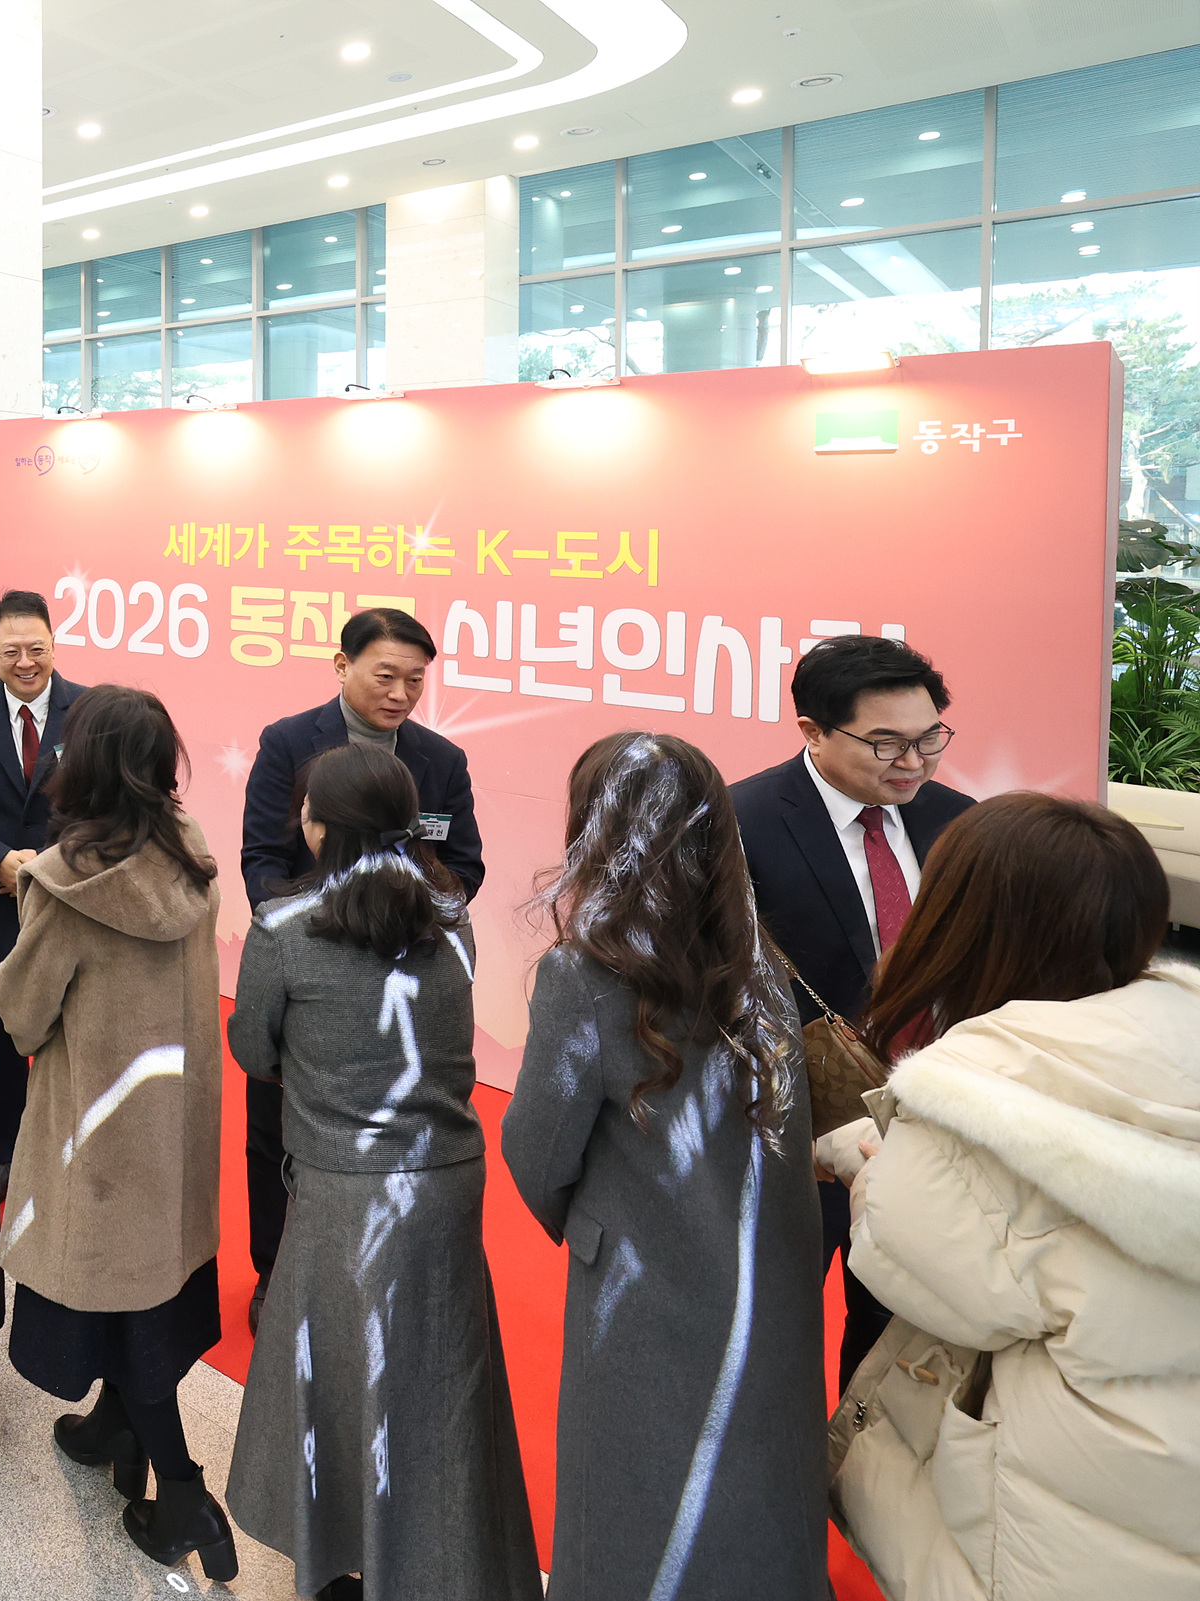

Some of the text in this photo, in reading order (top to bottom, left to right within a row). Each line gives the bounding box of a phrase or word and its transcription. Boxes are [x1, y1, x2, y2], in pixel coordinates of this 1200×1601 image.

[37, 454, 53, 466] 동작
[912, 418, 1023, 455] 동작구
[163, 522, 659, 587] 세계가 주목하는 K-도시
[54, 576, 210, 658] 2026
